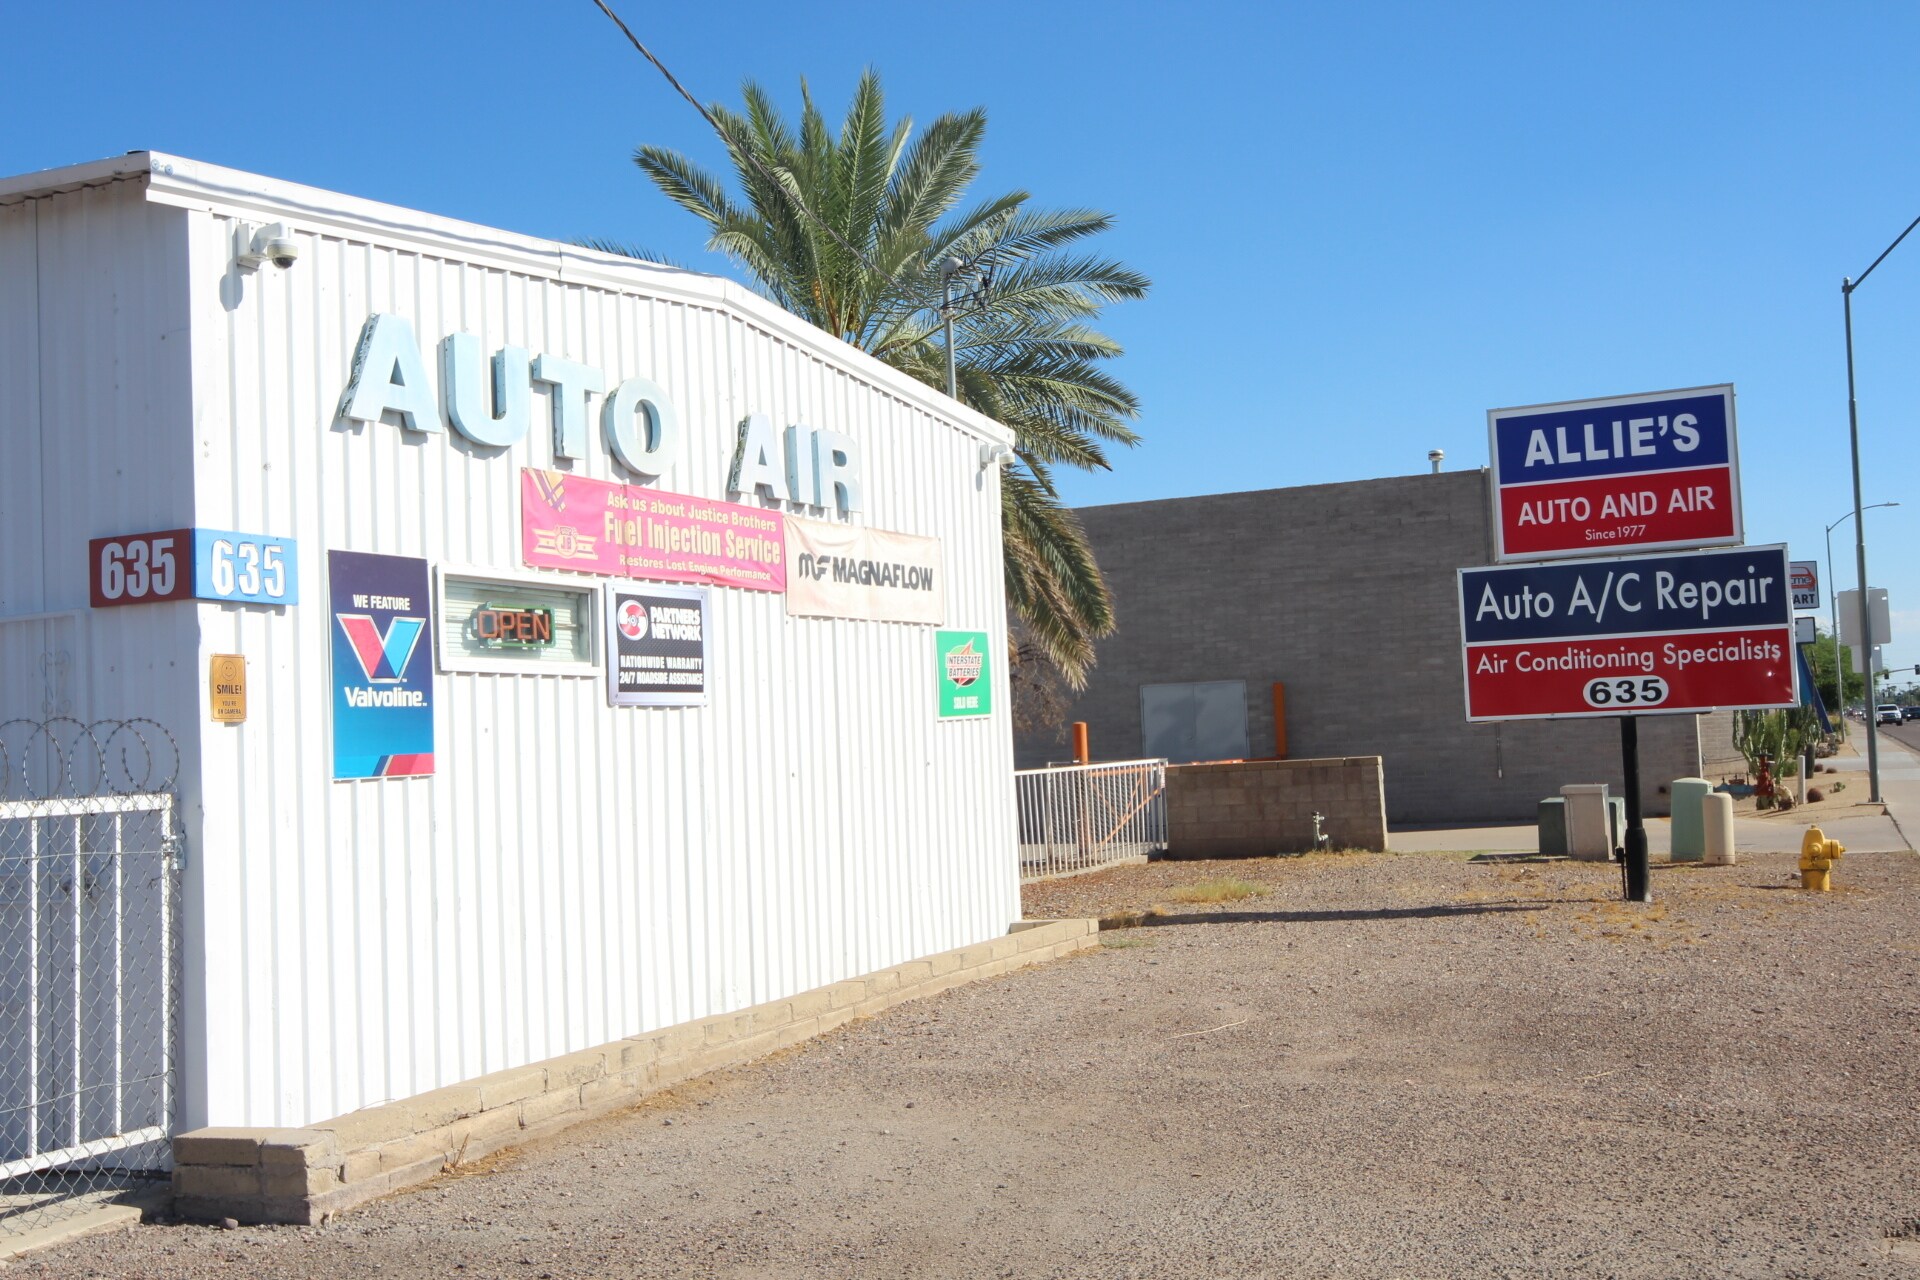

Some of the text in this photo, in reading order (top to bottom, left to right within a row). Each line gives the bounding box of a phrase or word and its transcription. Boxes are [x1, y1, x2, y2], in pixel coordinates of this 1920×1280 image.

[338, 312, 863, 515] AUTO AIR
[1524, 413, 1700, 467] ALLIE'S
[607, 491, 777, 532] Ask us about Justice Brothers
[1517, 485, 1715, 526] AUTO AND AIR
[604, 511, 781, 565] Fuel Injection Service
[1585, 524, 1646, 541] Since 1977
[101, 538, 176, 599] 635
[210, 538, 286, 598] 635
[619, 554, 771, 581] Restores Lost Engine Performance
[833, 556, 933, 591] MAGNAFLOW
[353, 594, 411, 611] WE FEATURE
[1475, 565, 1774, 623] Auto A/C Repair
[1793, 593, 1815, 605] ART
[478, 610, 550, 640] OPEN
[650, 606, 701, 625] PARTNERS
[651, 622, 702, 641] NETWORK
[620, 655, 703, 670] NATIONWIDE WARRANTY
[946, 655, 981, 665] INTERSTATE
[1476, 637, 1781, 674] Air Conditioning Specialists
[619, 671, 704, 685] 24/7 ROADSIDE ASSISTANCE
[948, 667, 979, 677] BATTERIES
[216, 684, 242, 695] SMILE!
[1588, 679, 1663, 705] 635
